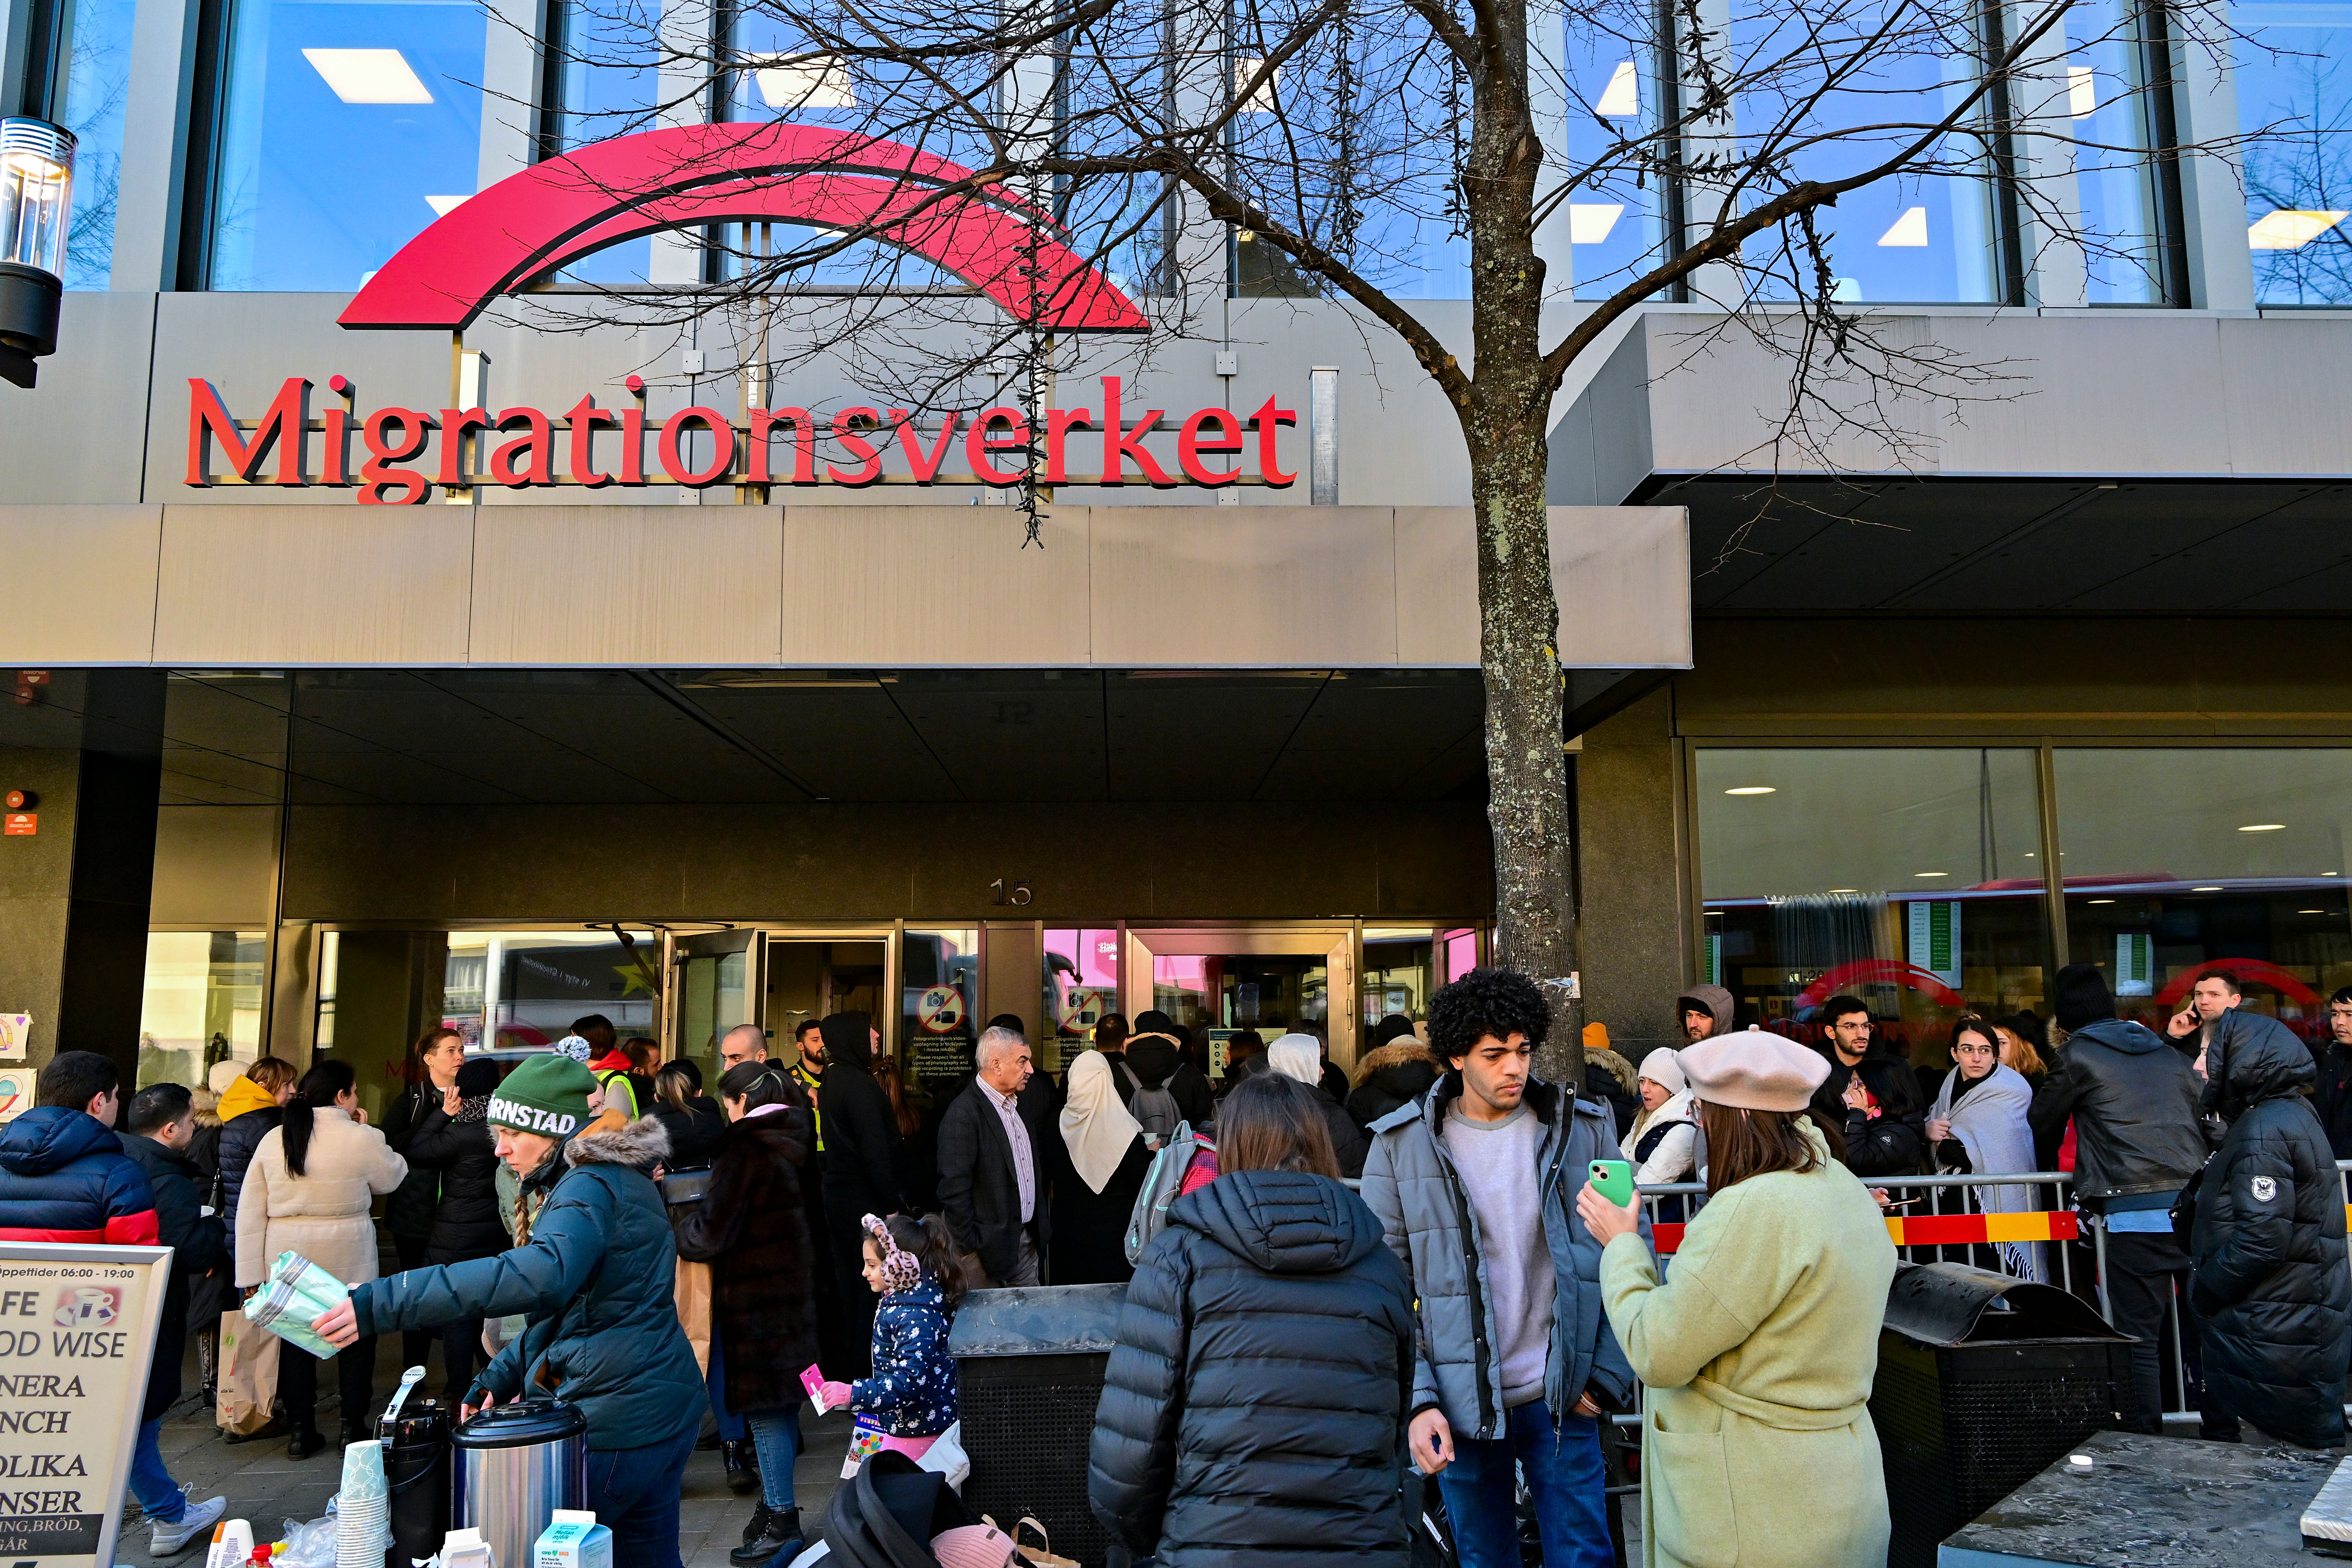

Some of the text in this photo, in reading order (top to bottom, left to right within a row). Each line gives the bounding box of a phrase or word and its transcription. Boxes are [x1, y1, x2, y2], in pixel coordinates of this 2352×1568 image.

[182, 375, 1298, 505] Migrationsverket
[990, 878, 1031, 906] 15
[0, 1266, 58, 1278] ppettider
[61, 1268, 93, 1277] 06:00
[104, 1269, 134, 1278] 19:00
[53, 1331, 127, 1357] WISE
